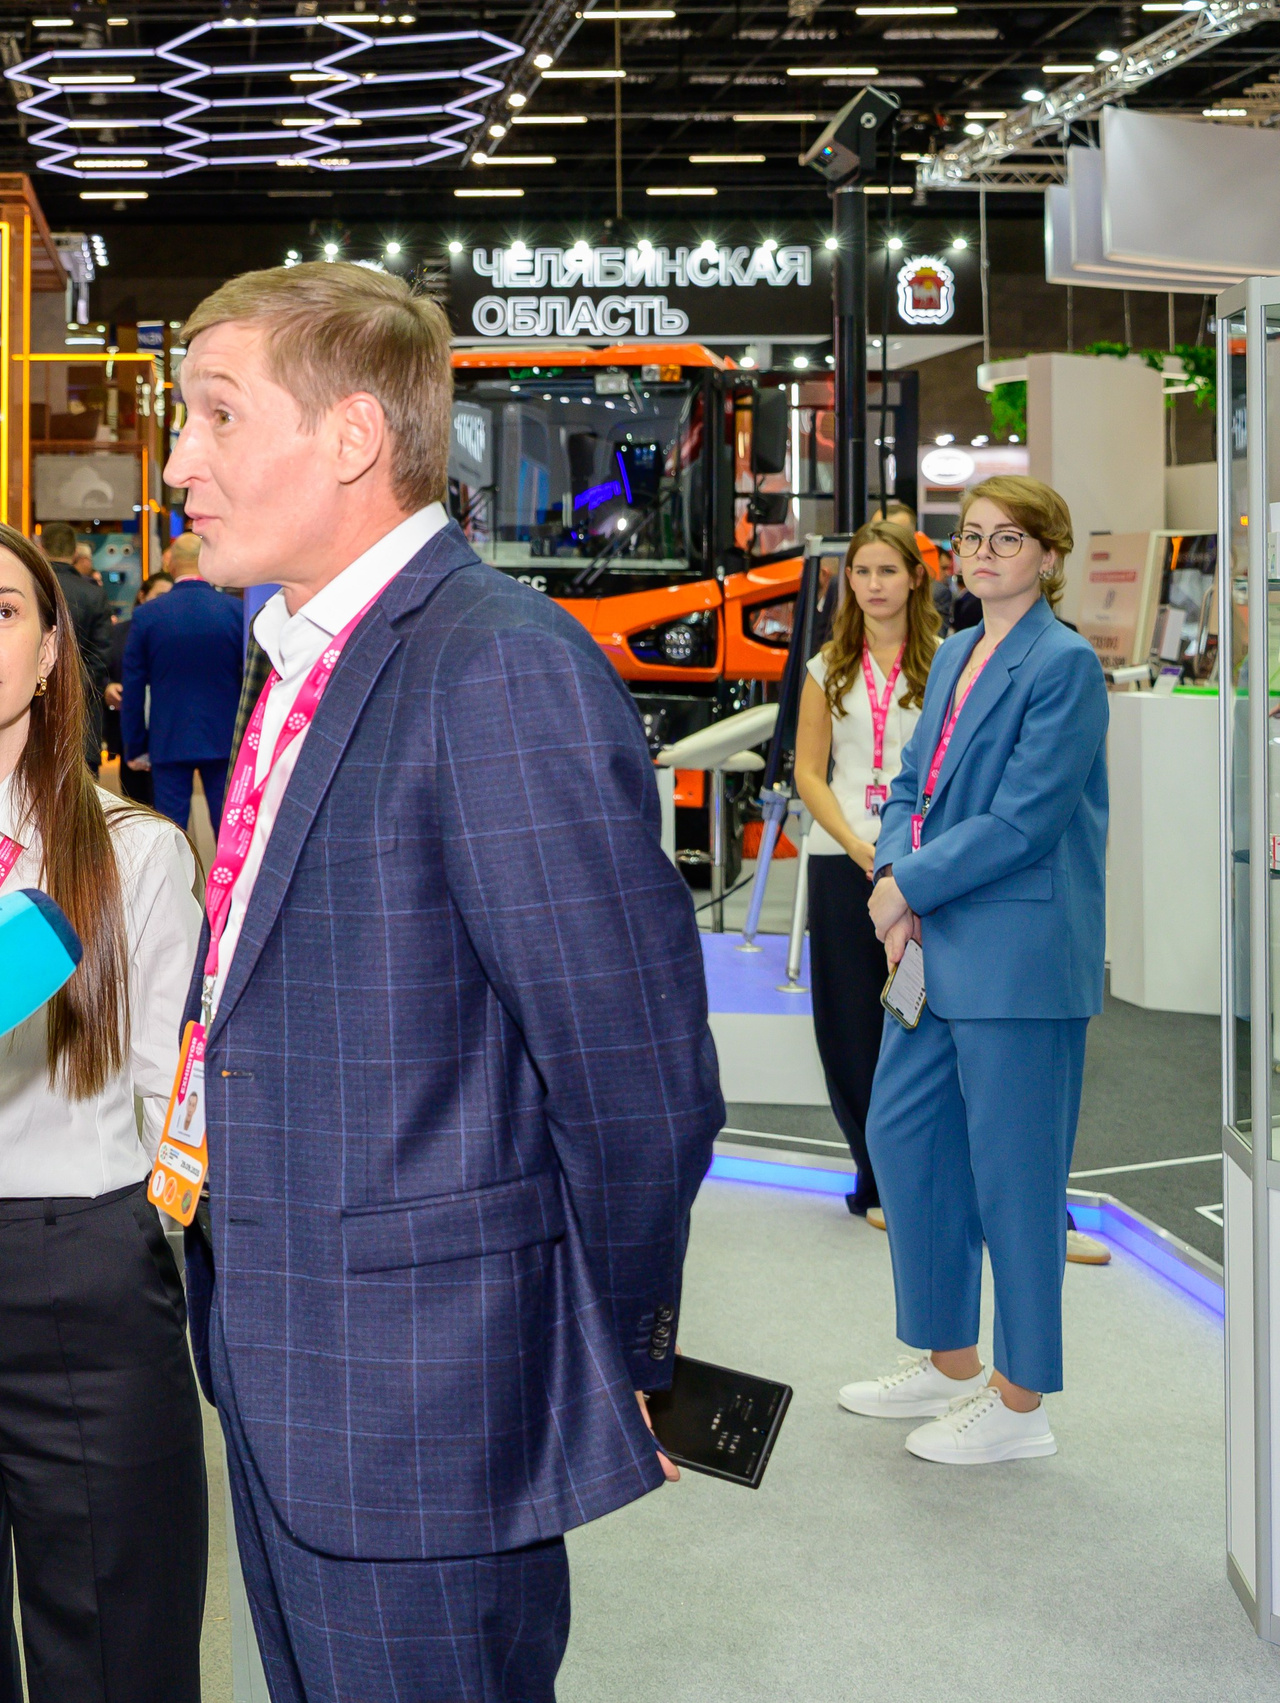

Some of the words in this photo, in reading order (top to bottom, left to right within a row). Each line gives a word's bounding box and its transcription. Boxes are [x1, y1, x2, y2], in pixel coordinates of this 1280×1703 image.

[472, 245, 812, 289] ЧЕЛЯБИНСКАЯ
[472, 294, 690, 336] ОБЛАСТЬ
[180, 1037, 198, 1095] EXHIBITOR
